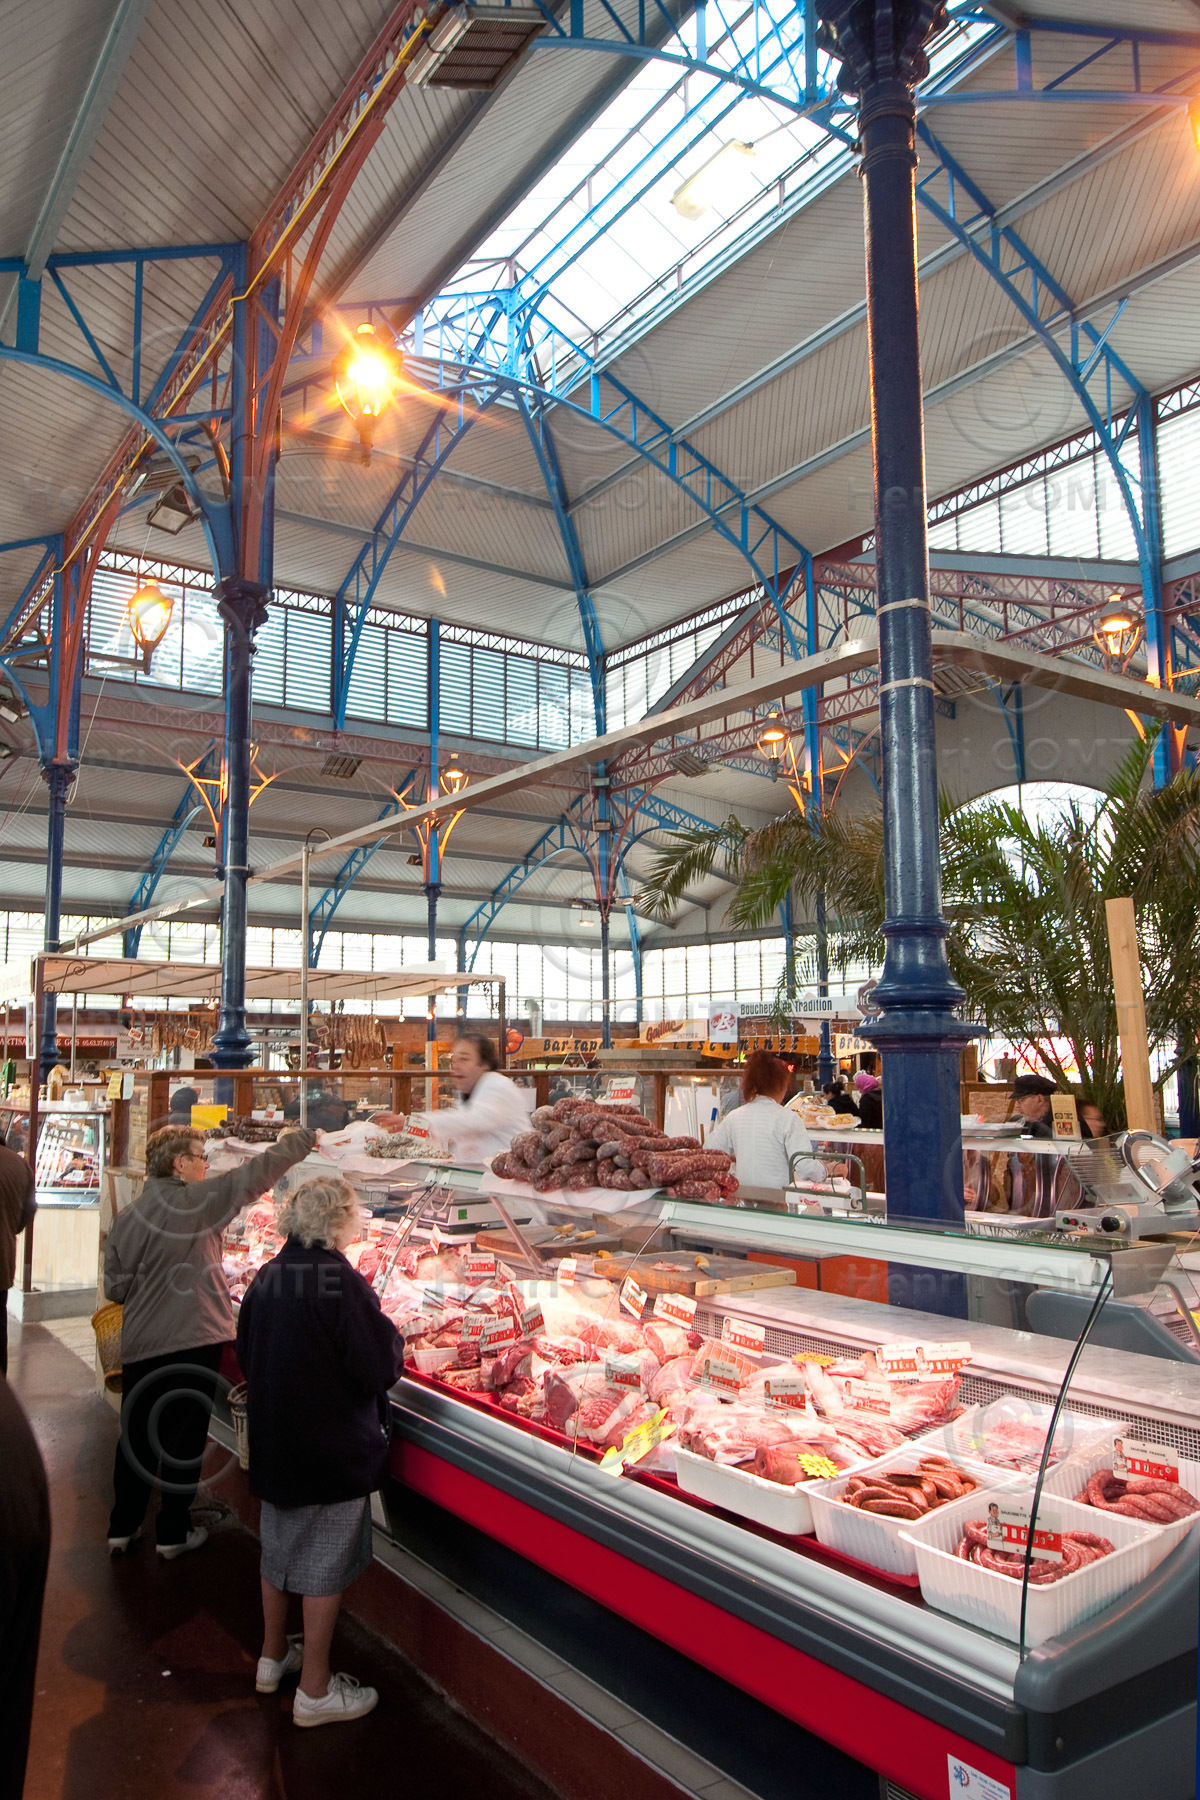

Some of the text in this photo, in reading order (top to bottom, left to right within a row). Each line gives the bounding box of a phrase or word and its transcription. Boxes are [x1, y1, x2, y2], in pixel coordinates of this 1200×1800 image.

[741, 1003, 780, 1015] Boucher
[794, 1000, 833, 1013] Tradition
[646, 1020, 684, 1043] Gaillac
